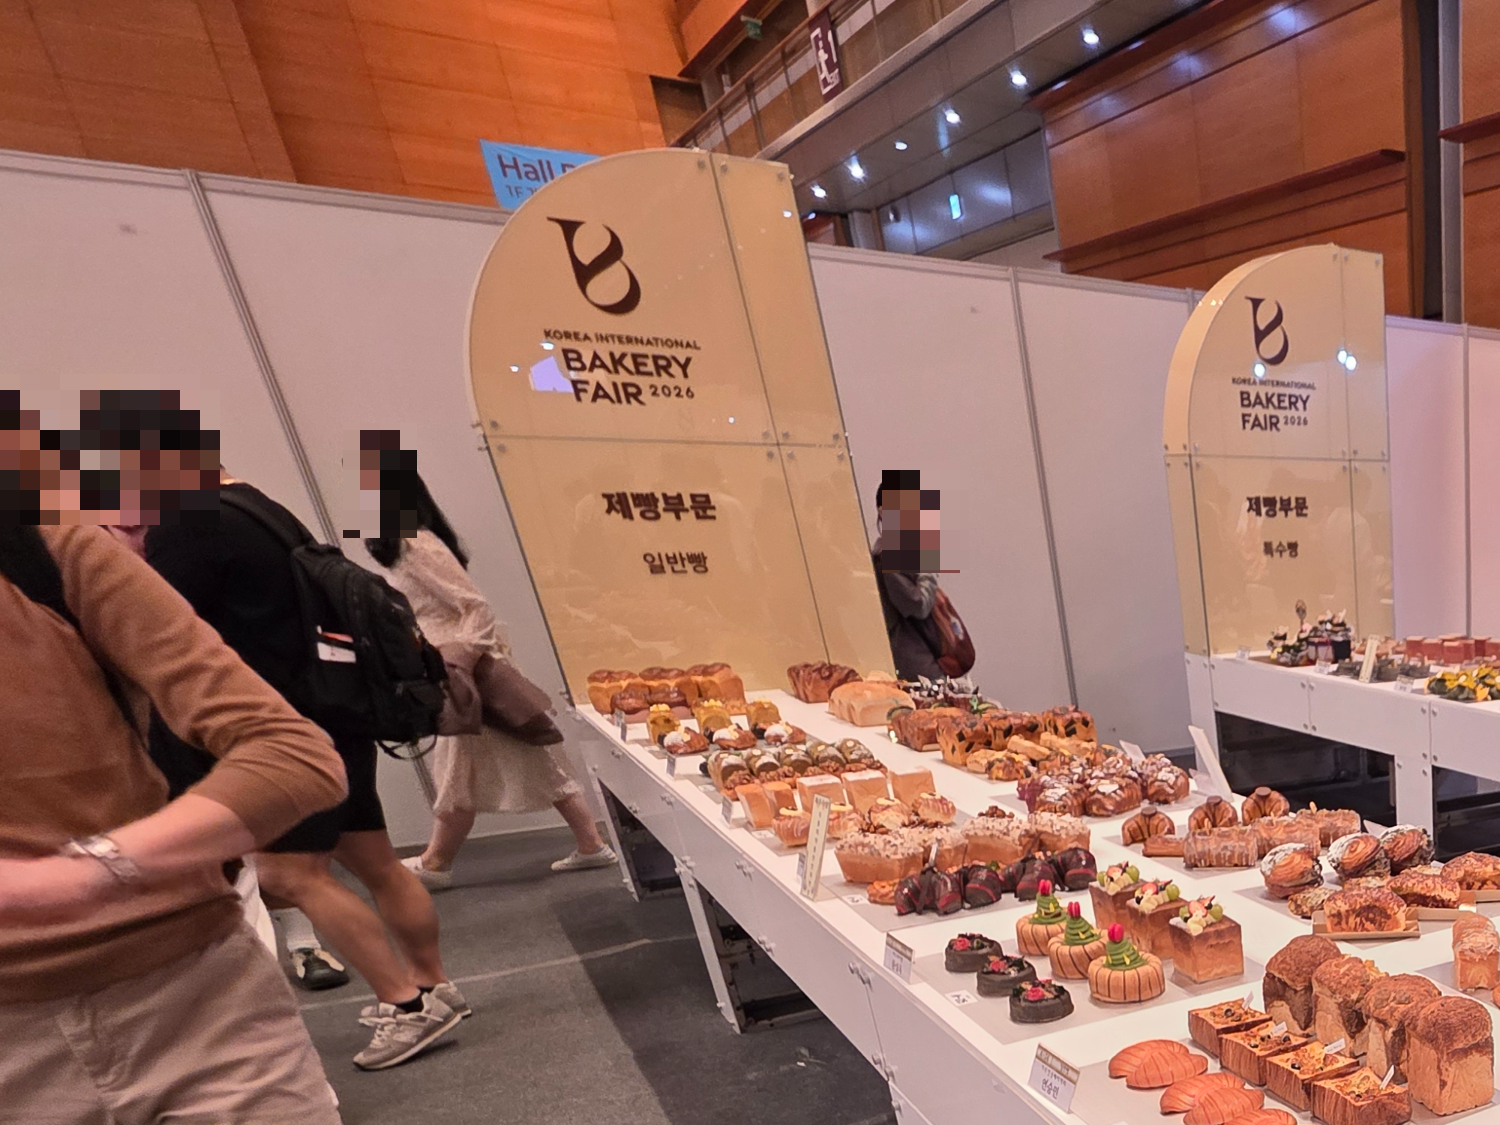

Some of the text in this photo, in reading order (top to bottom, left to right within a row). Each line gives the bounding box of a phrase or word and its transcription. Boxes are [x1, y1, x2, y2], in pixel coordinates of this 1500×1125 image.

[497, 154, 554, 183] Hall
[543, 329, 701, 350] KOREA INTERNATIONAL
[561, 348, 692, 379] BAKERY
[570, 379, 695, 406] FAIR 2026
[1232, 376, 1316, 391] KOREA INTERNATIONAL
[1239, 390, 1310, 412] BAKERY
[1241, 412, 1308, 432] FAIR 2026
[601, 491, 717, 521] 제빵부문
[1246, 495, 1308, 518] 제빵부문
[642, 551, 709, 575] 일반빵
